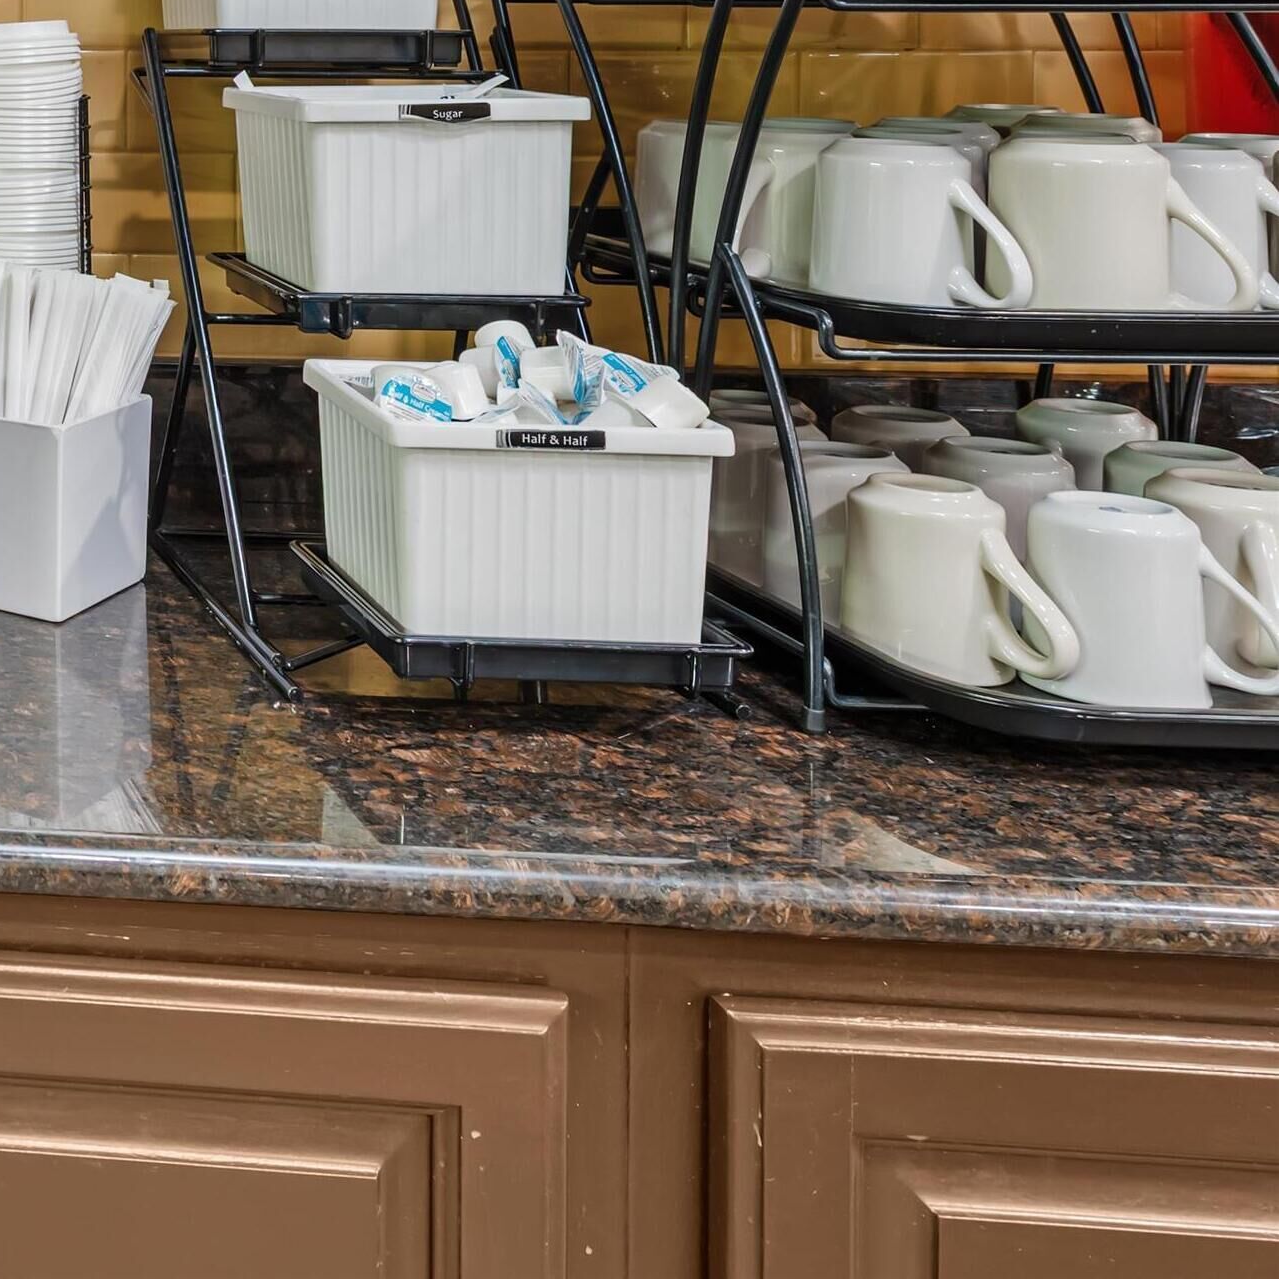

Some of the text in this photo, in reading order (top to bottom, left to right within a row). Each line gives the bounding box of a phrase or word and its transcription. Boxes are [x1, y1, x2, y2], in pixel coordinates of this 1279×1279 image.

[432, 108, 464, 121] Sugar
[521, 432, 588, 447] Half & Half
